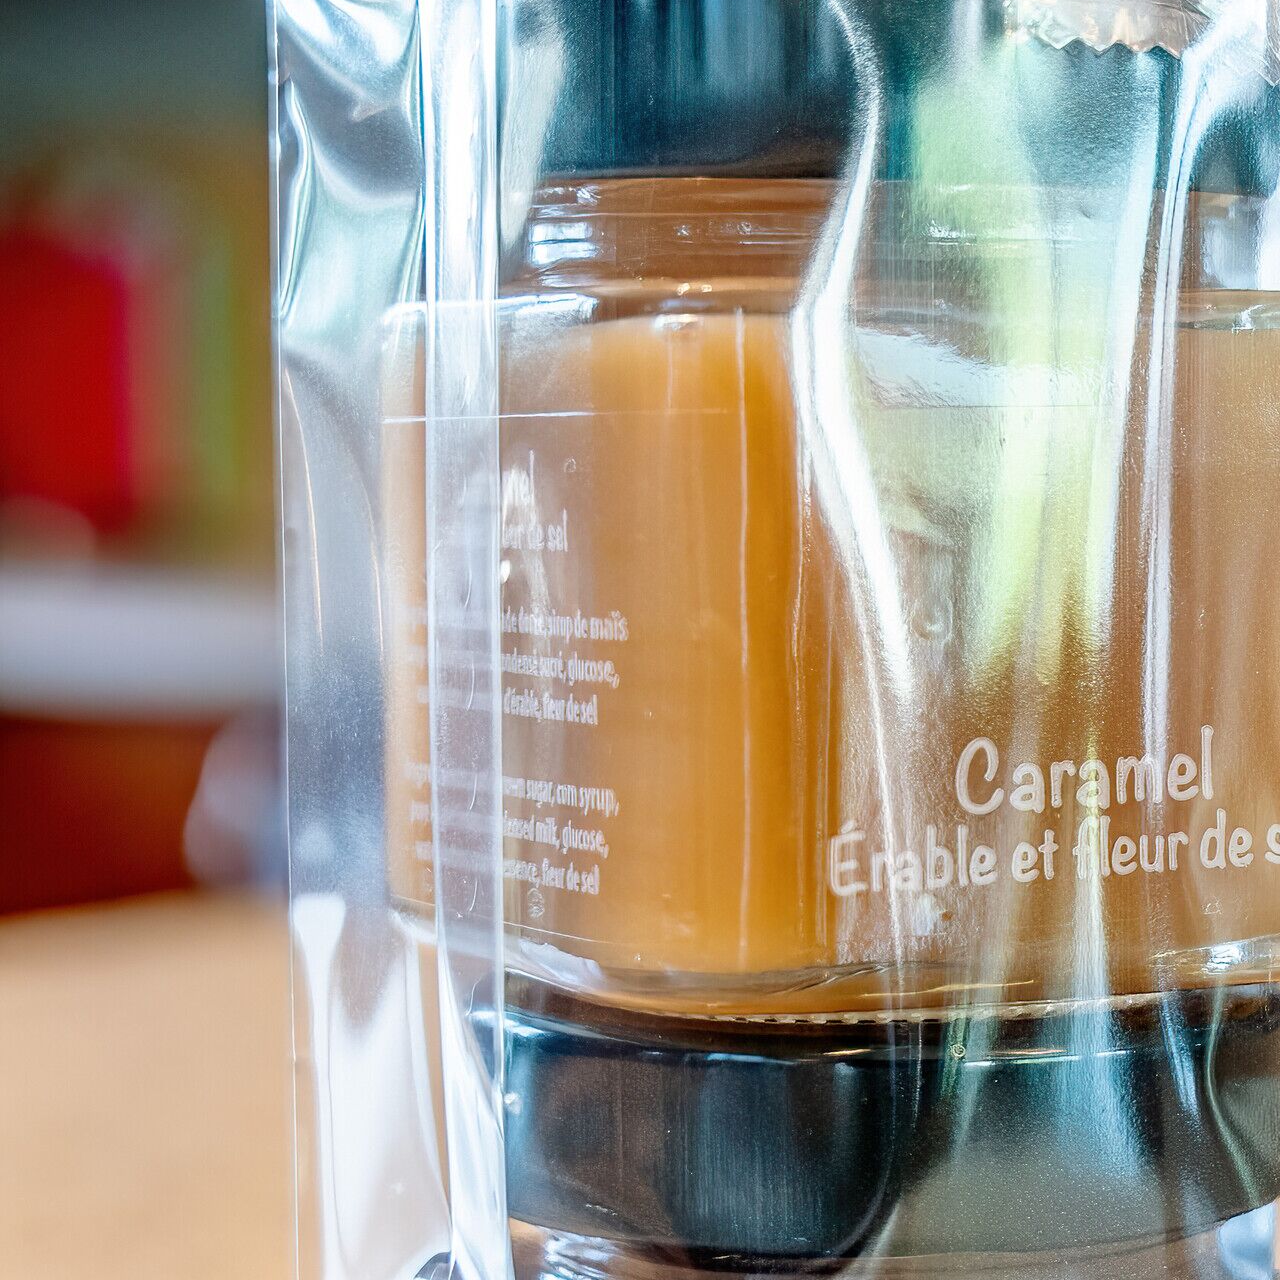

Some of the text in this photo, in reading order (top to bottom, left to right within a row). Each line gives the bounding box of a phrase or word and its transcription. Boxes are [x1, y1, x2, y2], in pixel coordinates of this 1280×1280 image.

[567, 651, 620, 689] glucose,
[955, 725, 1214, 815] Caramel
[562, 819, 609, 859] glucose,
[828, 821, 999, 896] Érable
[1011, 829, 1058, 882] et
[1074, 816, 1189, 880] fleur
[1200, 808, 1255, 870] de
